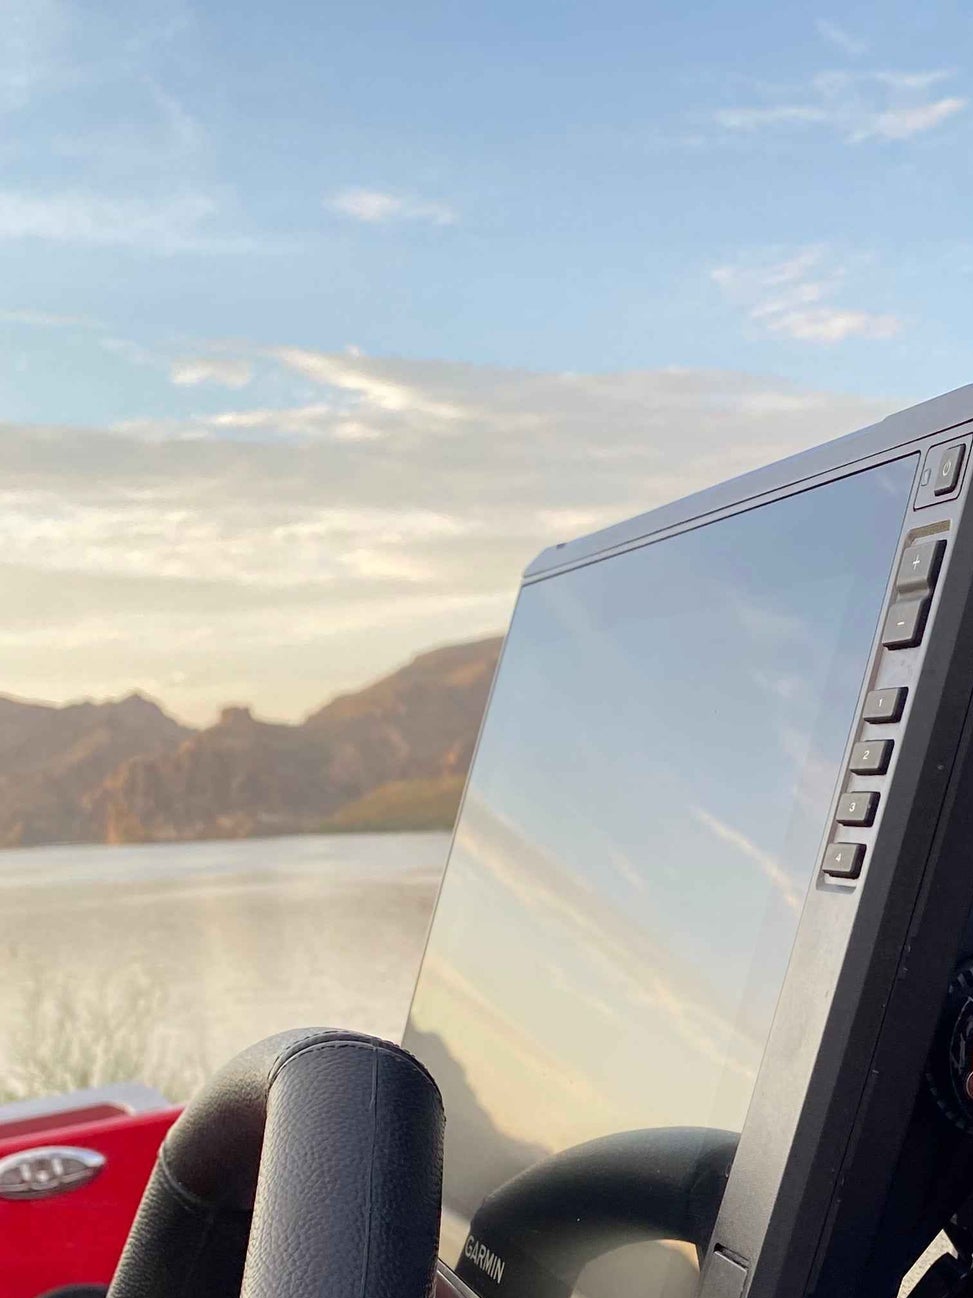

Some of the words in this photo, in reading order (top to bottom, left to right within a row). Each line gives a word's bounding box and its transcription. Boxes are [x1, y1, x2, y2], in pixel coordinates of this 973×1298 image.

[877, 696, 884, 708] 1
[862, 749, 871, 761] 2
[848, 801, 857, 813] 3
[834, 852, 843, 864] 4
[464, 1235, 506, 1284] GARMIN
